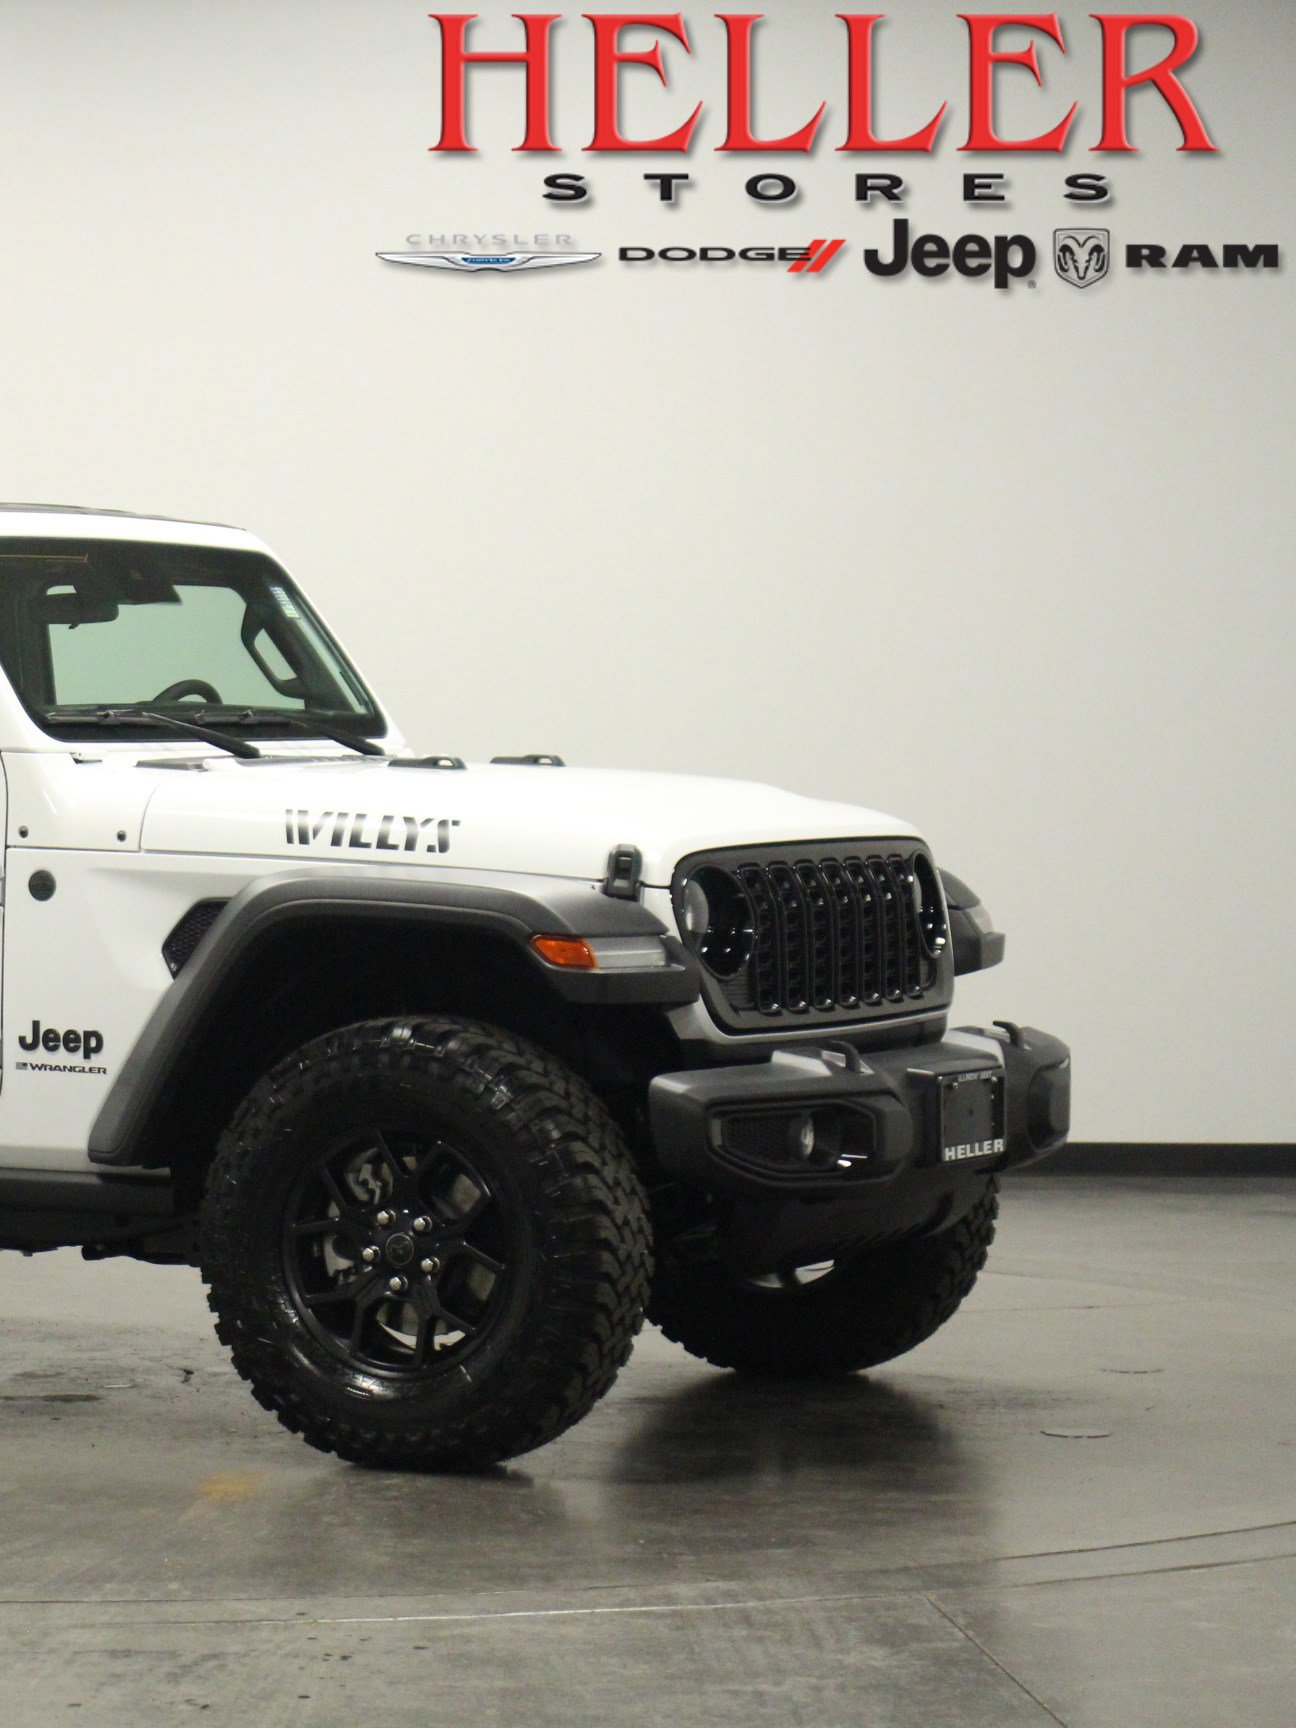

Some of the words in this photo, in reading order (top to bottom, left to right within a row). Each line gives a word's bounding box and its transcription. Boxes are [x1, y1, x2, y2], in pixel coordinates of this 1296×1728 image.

[285, 808, 462, 854] WILLYS
[18, 1019, 104, 1060] Jeep
[29, 1062, 107, 1075] WRANGLER
[944, 1138, 1005, 1162] HELLER
